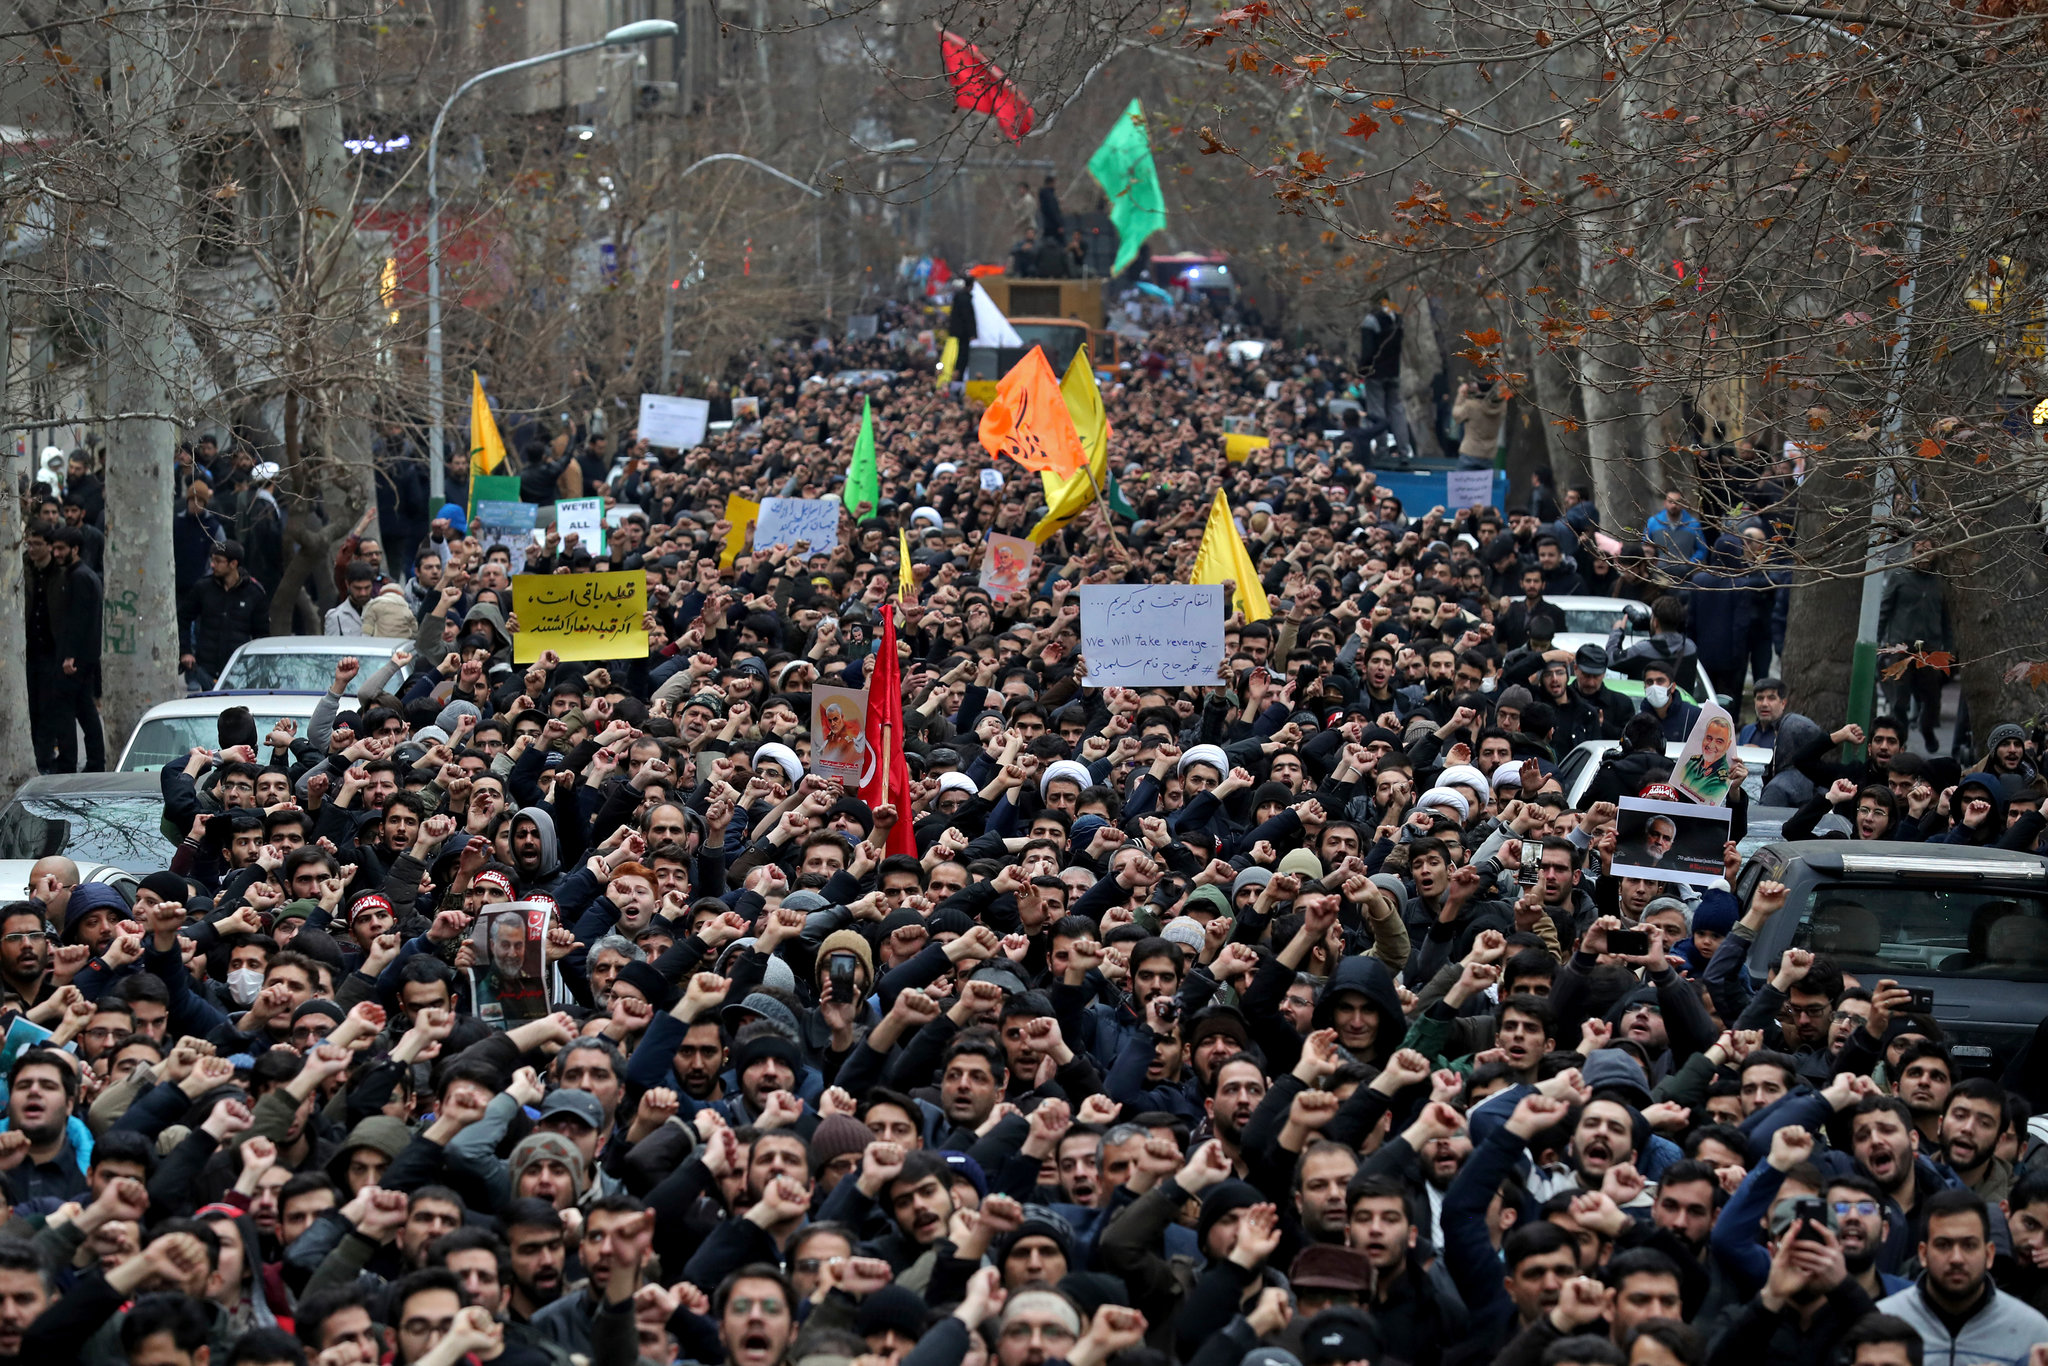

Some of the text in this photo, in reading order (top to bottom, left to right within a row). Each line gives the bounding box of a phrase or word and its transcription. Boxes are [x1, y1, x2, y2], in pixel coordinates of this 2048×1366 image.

[562, 502, 596, 511] WE'RE
[569, 521, 590, 529] ALL
[575, 582, 603, 609] باقی
[603, 582, 635, 608] قبله
[1151, 592, 1185, 608] سخت
[1132, 599, 1145, 614] می
[1183, 593, 1213, 628] انتقام
[530, 610, 577, 633] کشتند
[588, 618, 618, 640] قبله
[609, 612, 637, 642] اگر
[1111, 635, 1131, 646] will
[1135, 634, 1162, 647] take
[1166, 637, 1208, 653] revenge
[1091, 657, 1143, 677] سلیمانی
[1143, 657, 1159, 677] قاسم
[1162, 662, 1181, 680] حاج
